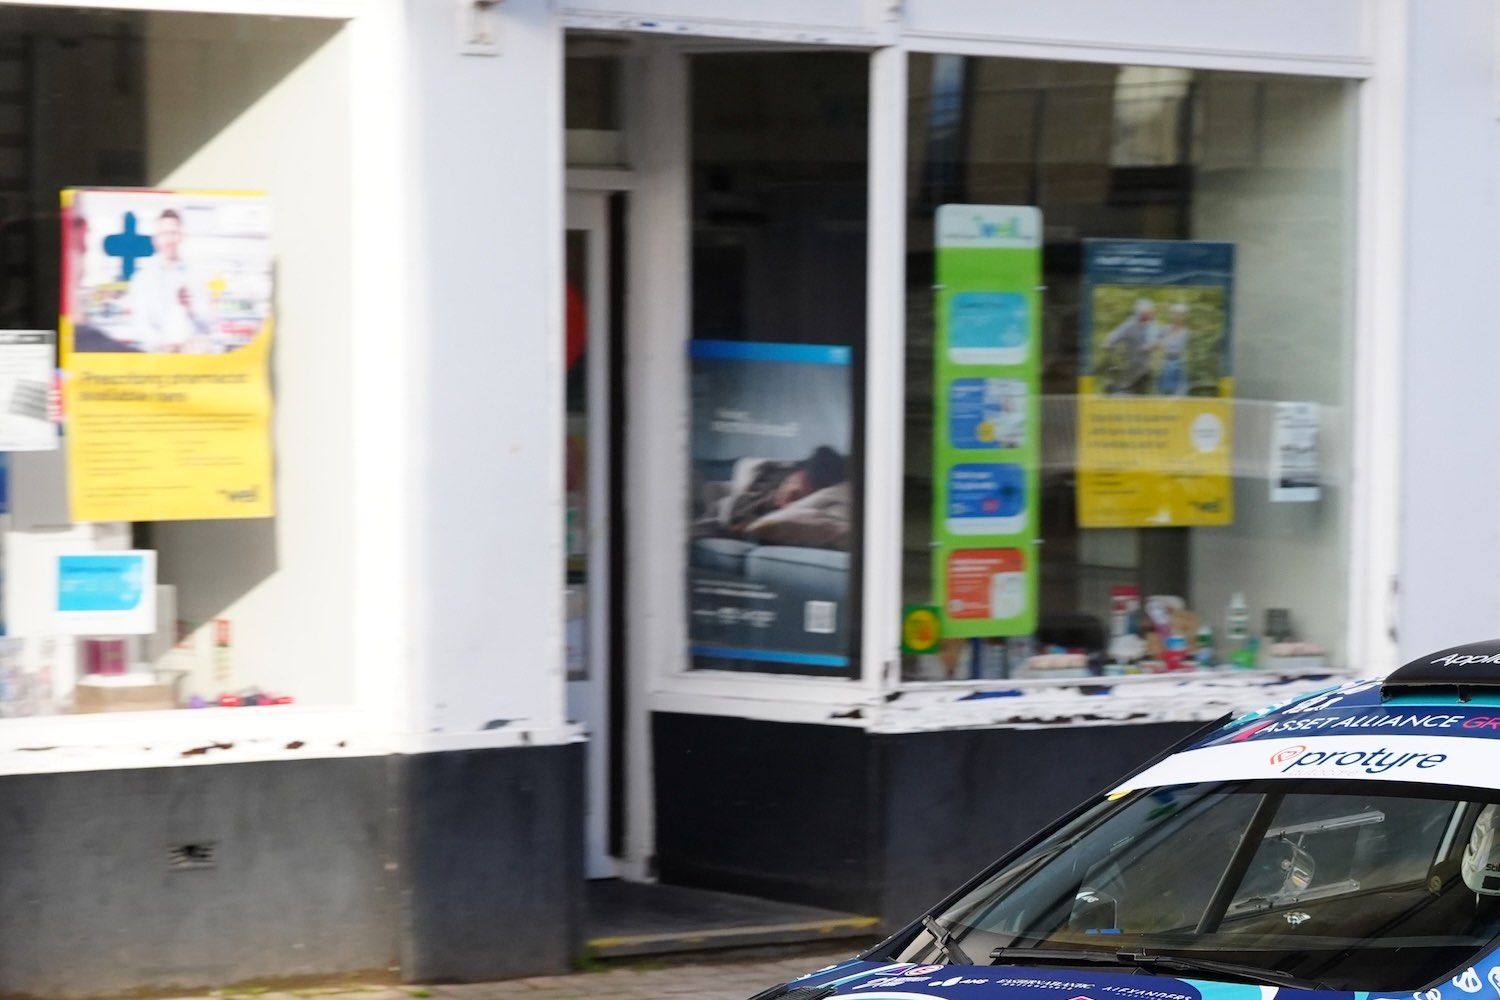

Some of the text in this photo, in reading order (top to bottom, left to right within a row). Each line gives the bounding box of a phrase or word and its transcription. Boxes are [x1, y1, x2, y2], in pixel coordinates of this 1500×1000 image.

[1255, 716, 1340, 734] ASSET
[1331, 714, 1465, 729] ALLIANCE
[1281, 748, 1448, 774] protyre
